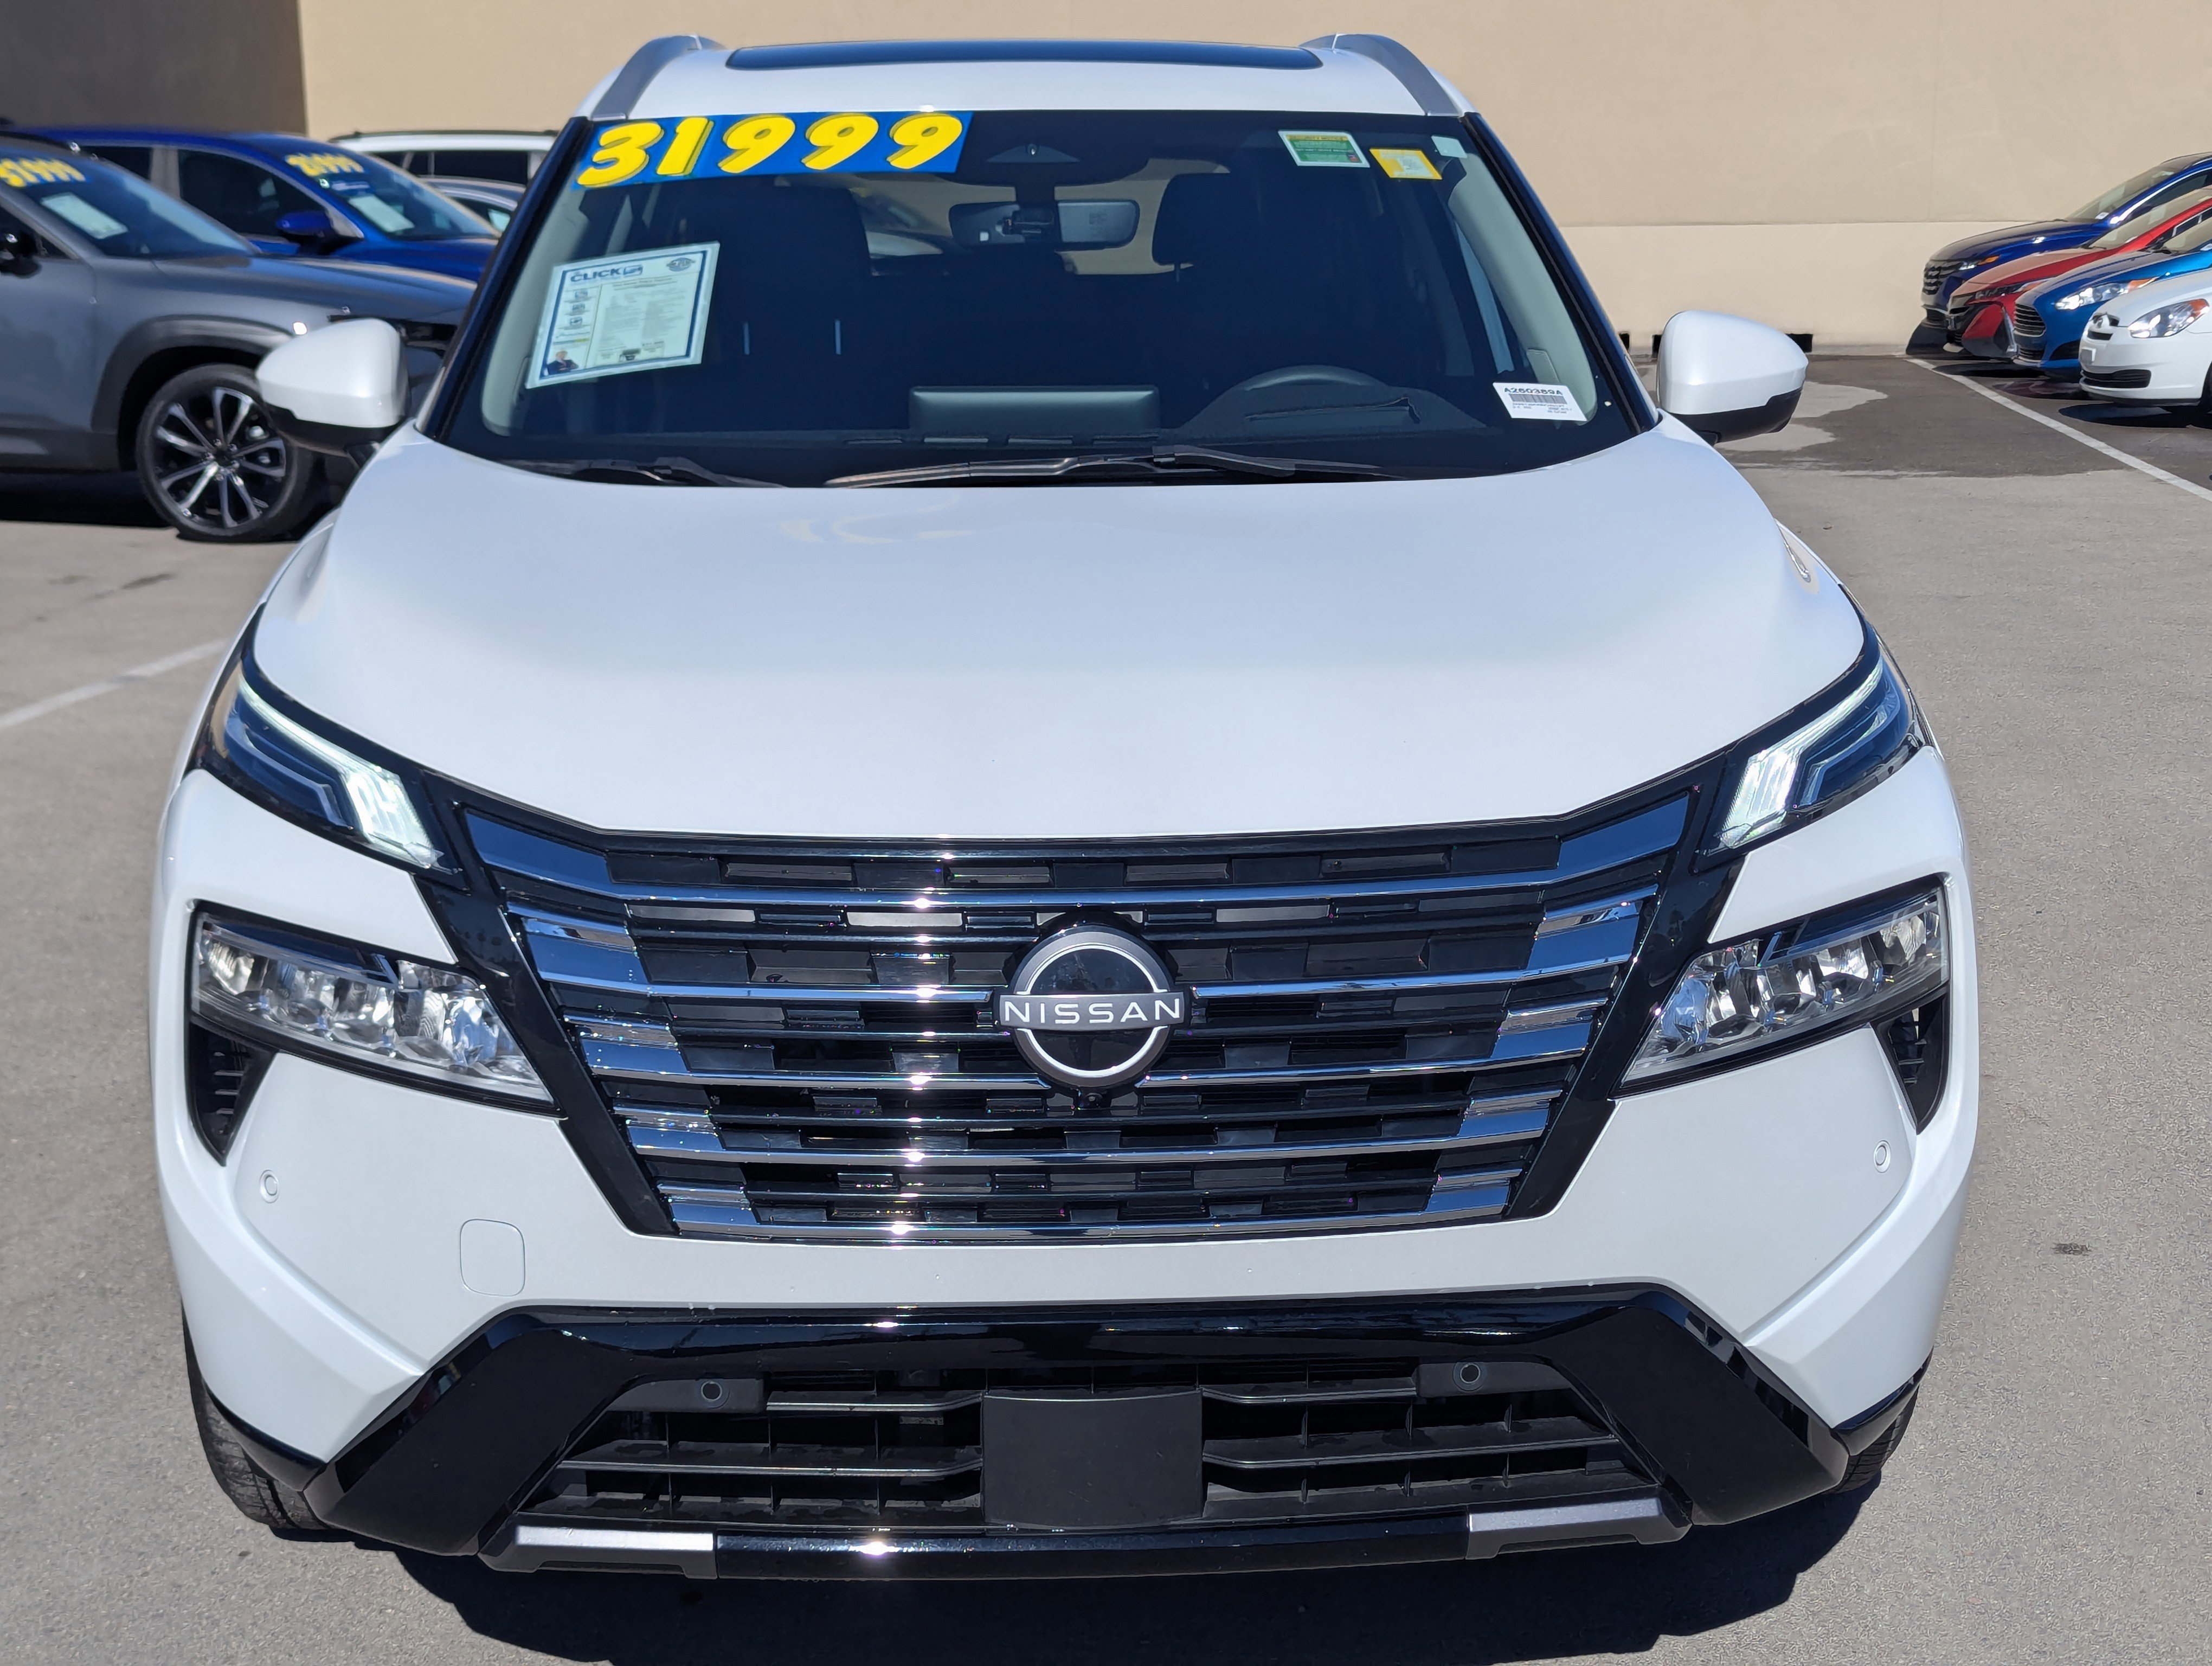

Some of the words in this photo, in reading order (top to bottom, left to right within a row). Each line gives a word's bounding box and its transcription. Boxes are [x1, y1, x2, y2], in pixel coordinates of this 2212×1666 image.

[577, 113, 962, 188] 31999
[570, 267, 623, 281] CLICK
[1005, 998, 1180, 1023] NISSAN
